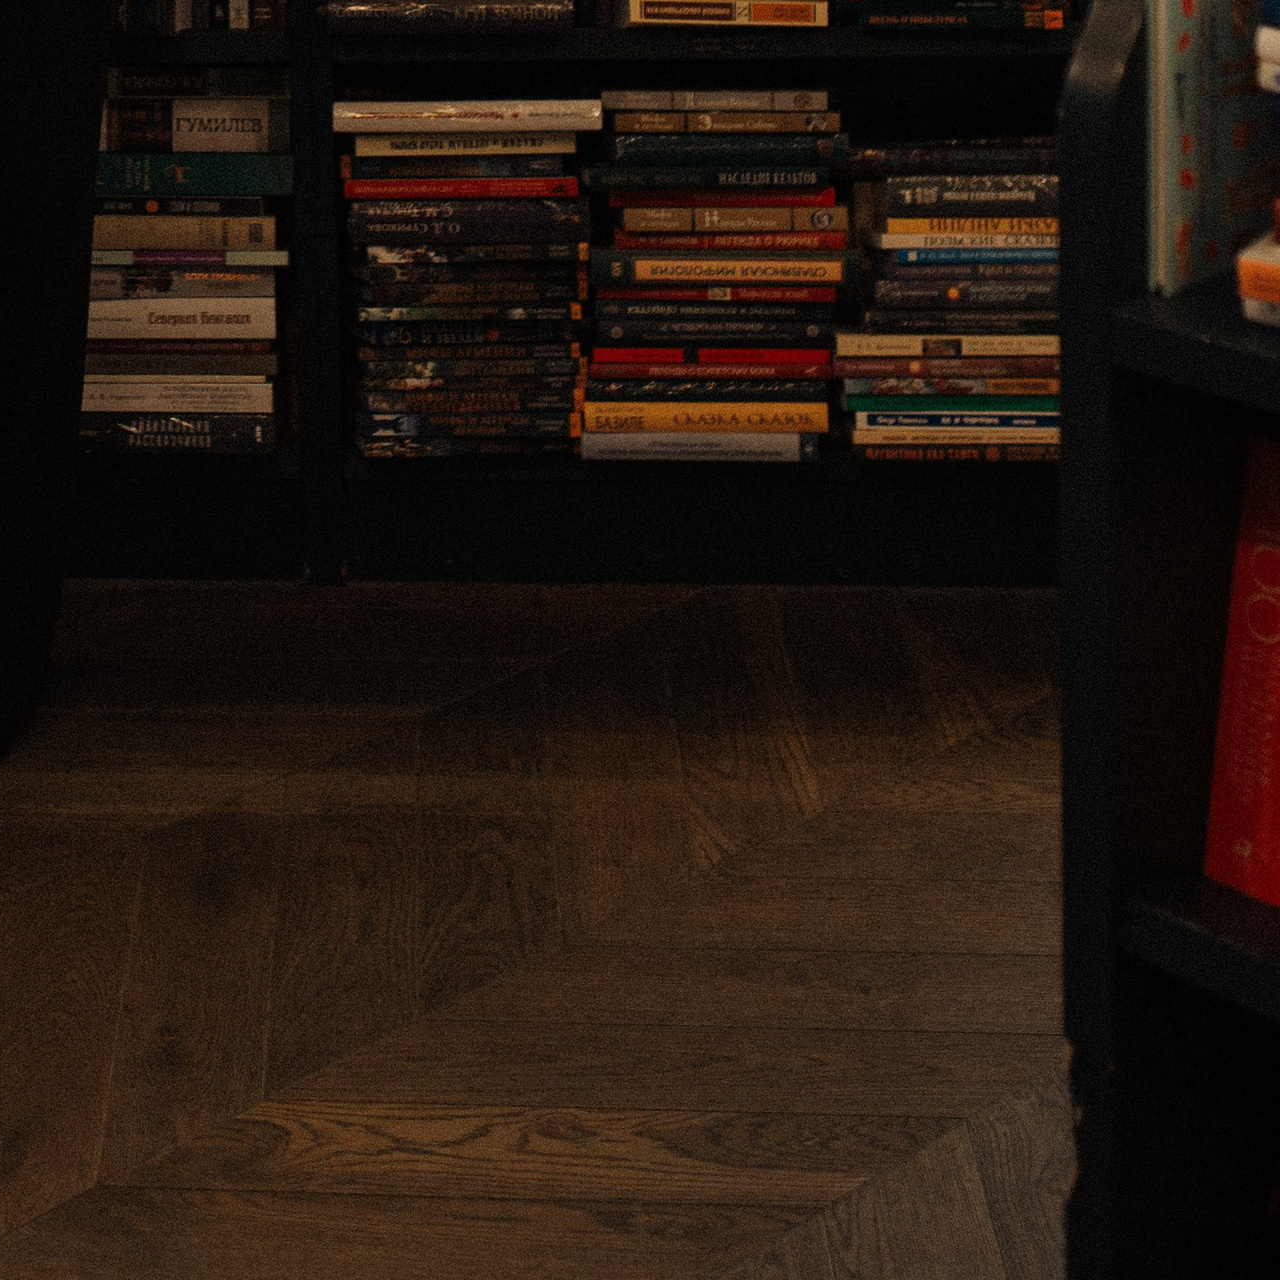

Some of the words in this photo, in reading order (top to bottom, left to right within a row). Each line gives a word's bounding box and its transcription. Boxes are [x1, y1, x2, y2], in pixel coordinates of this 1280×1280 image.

[175, 117, 263, 133] ГУМИЛЕВ
[739, 266, 828, 279] СЛАВЯНСКАЯ
[673, 413, 741, 427] СКАЗКА
[745, 411, 814, 426] СКАЗОК
